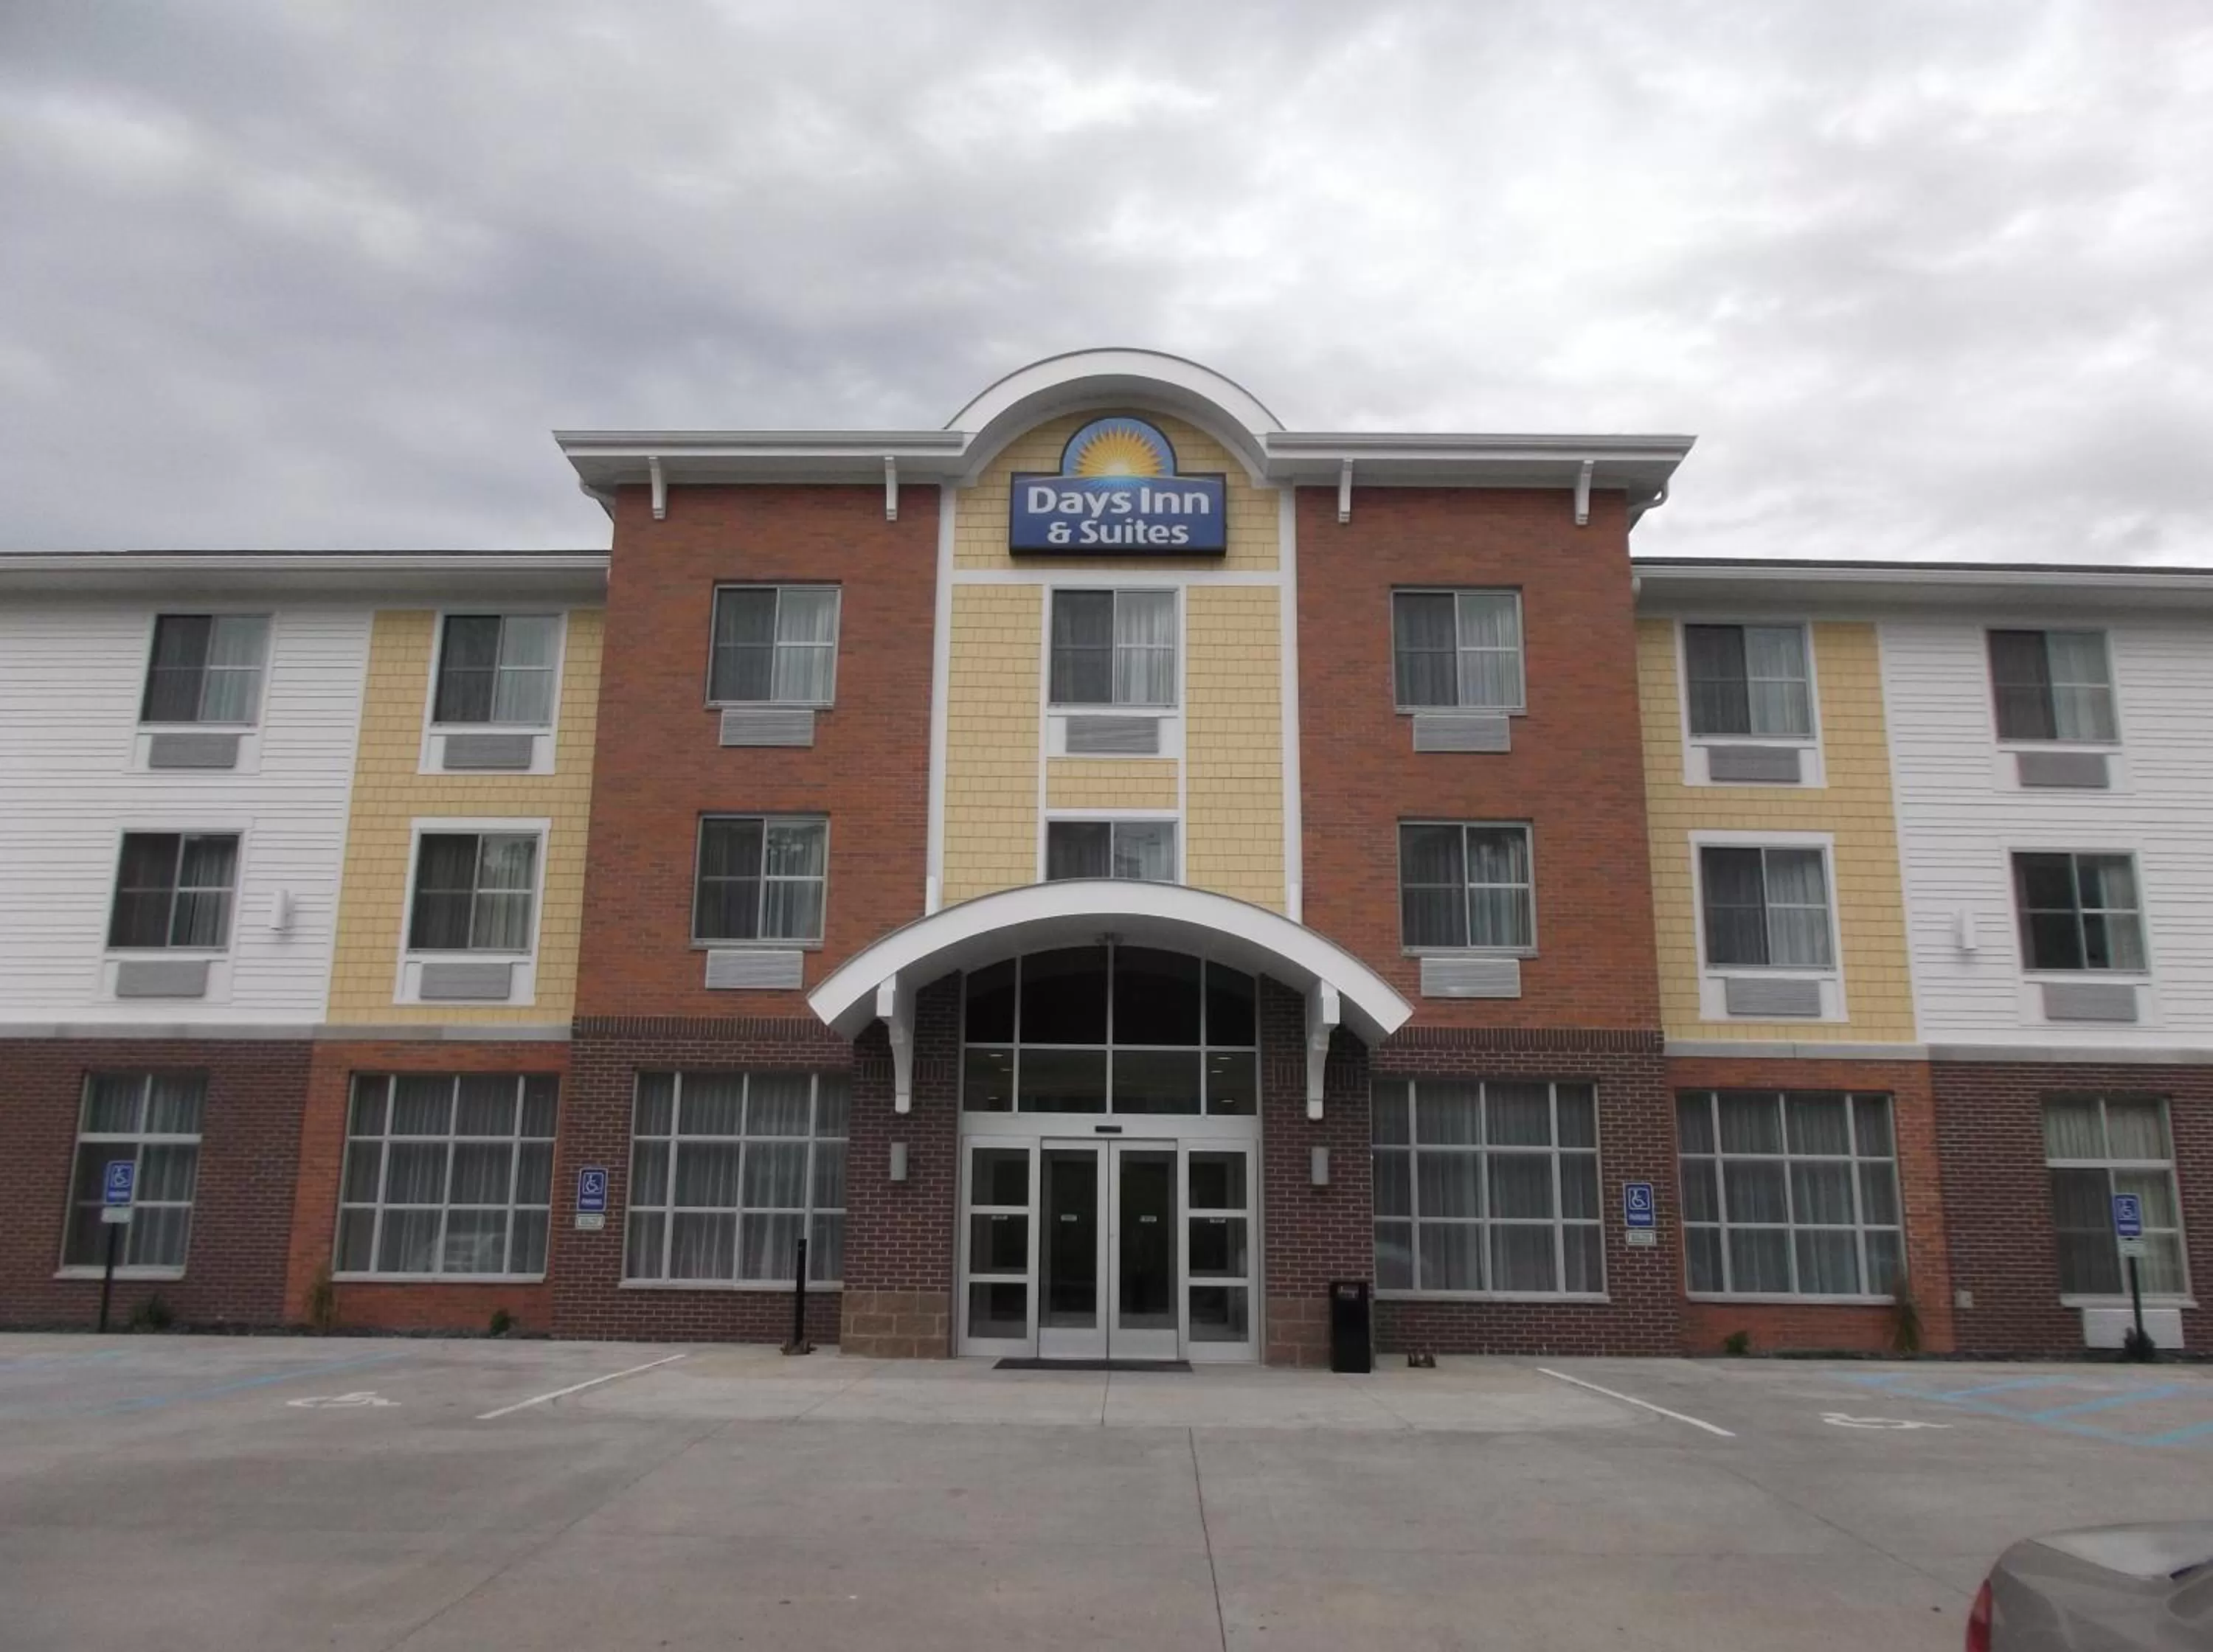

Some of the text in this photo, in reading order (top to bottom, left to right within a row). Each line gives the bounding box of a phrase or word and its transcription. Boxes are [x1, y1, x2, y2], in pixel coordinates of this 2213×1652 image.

[1028, 486, 1209, 518] Days Inn
[1047, 518, 1189, 544] & Suites
